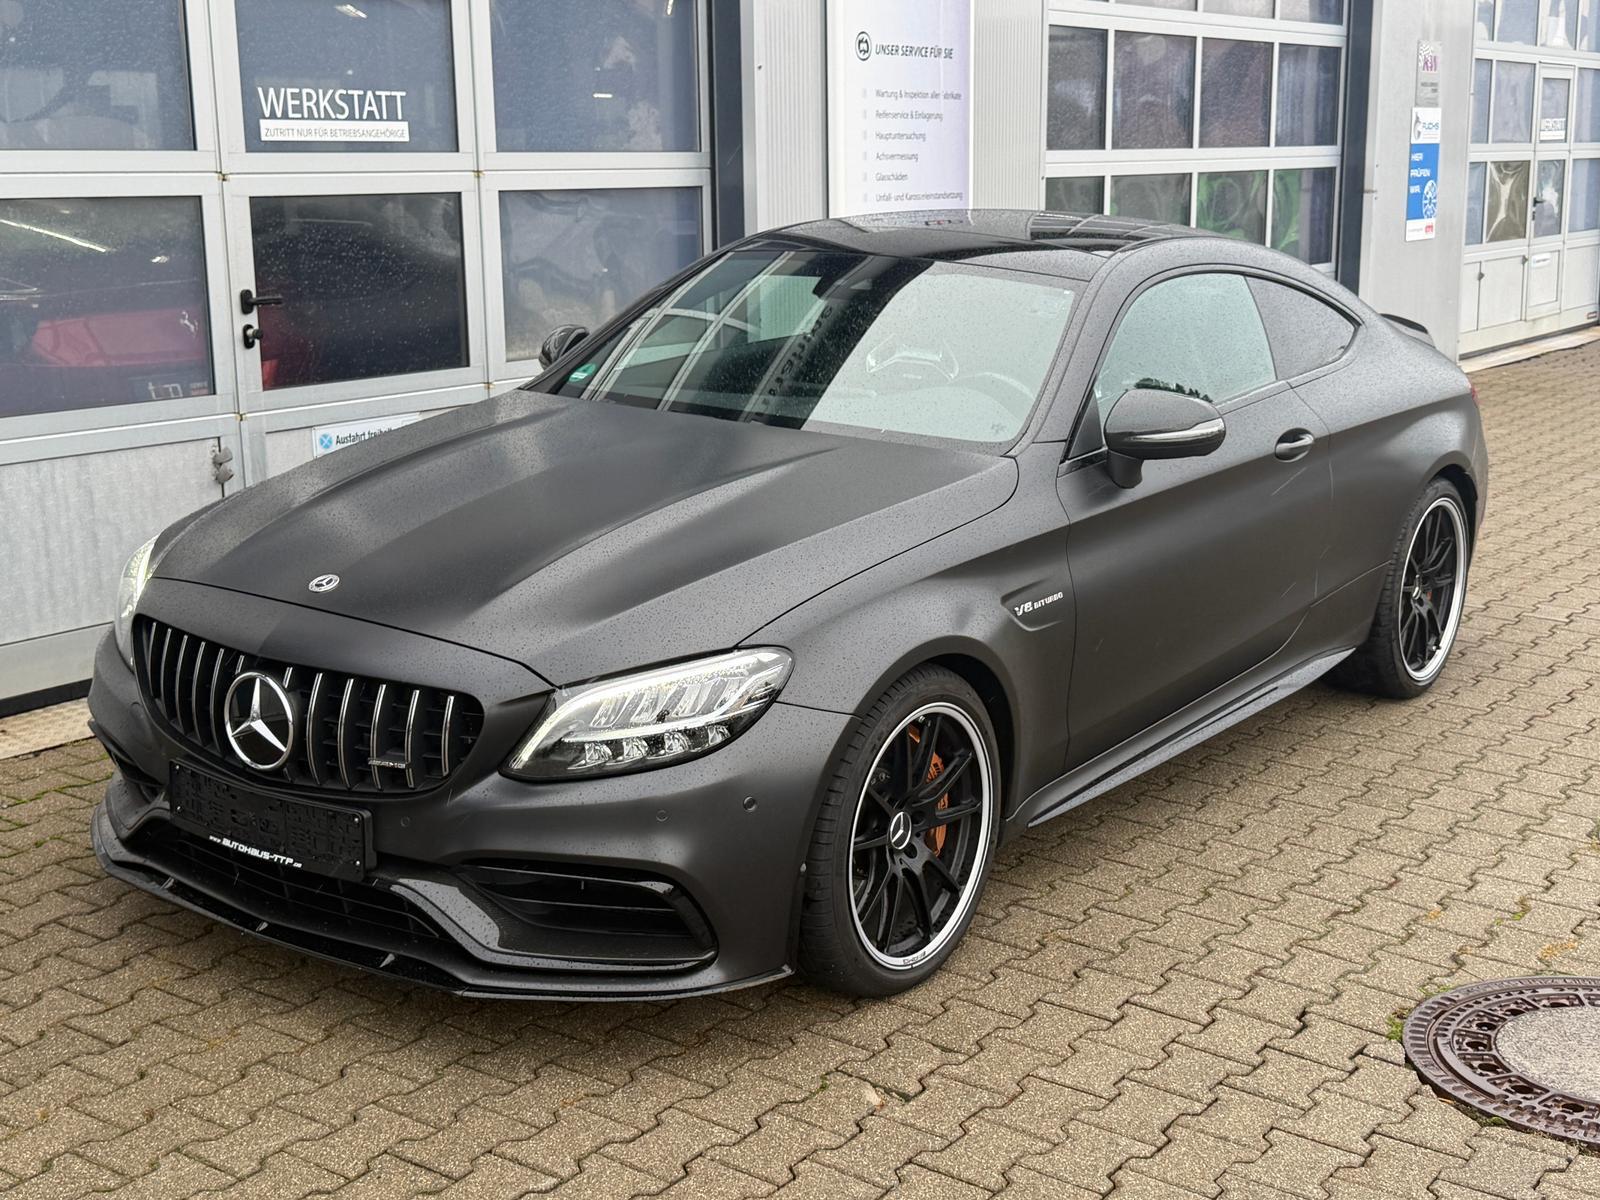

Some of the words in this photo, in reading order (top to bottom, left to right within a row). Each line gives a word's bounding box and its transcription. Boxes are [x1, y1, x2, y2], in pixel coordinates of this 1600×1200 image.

[875, 43, 900, 56] UNSER
[901, 45, 929, 58] SERVICE
[930, 44, 943, 58] FÜR
[944, 48, 954, 60] SIE
[875, 89, 898, 101] Wartung
[904, 91, 929, 101] Inspektion
[942, 91, 962, 101] abrikate
[257, 86, 407, 120] WERKSTATT
[875, 110, 909, 120] Reifenservice
[914, 111, 943, 122] Einlagerung
[265, 127, 295, 138] ZUTRITT
[297, 127, 313, 138] NUR
[314, 126, 329, 138] FÜR
[329, 127, 406, 139] BETRIEBSANGEHÖRIGE
[875, 131, 926, 142] Hauptuntersuchung
[1410, 167, 1431, 178] PRÜFEN
[875, 192, 892, 203] Unfall-
[894, 192, 904, 202] und
[336, 431, 367, 446] Ausfahrt
[1014, 601, 1033, 616] V8
[1033, 591, 1064, 610] BITURBO
